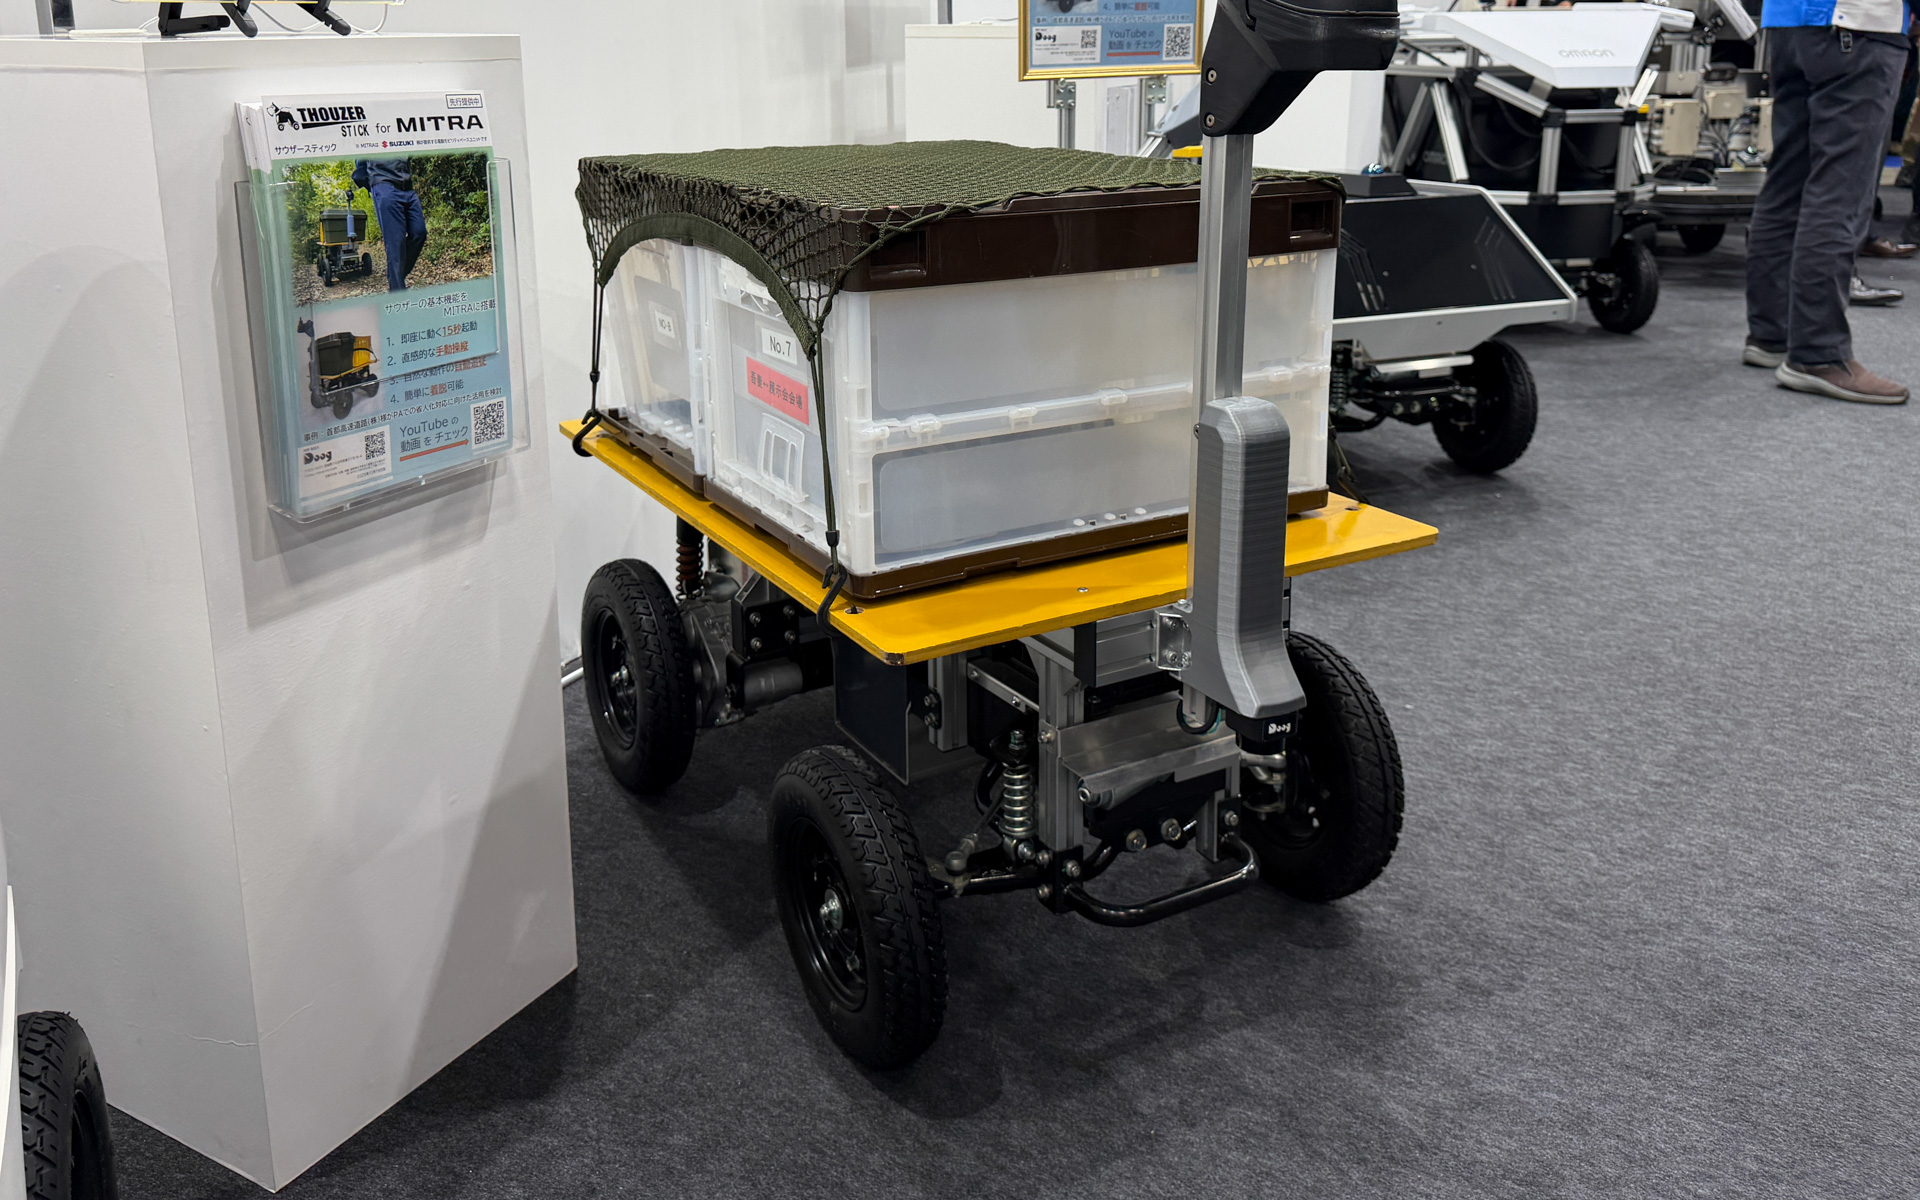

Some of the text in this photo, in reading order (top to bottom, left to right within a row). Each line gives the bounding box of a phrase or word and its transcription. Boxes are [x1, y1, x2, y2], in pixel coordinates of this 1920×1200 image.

[1109, 29, 1147, 39] YouTube
[1134, 40, 1162, 49] チェック
[296, 106, 367, 122] THOUZER
[341, 115, 484, 137] STICK for MITRA
[274, 143, 337, 155] サウザースティック
[384, 292, 468, 315] サウザーの基本機能を
[443, 299, 497, 317] MITRAに搭載
[386, 321, 478, 347] 1. 即座に動く15秒起動
[769, 335, 792, 358] No.7
[387, 355, 397, 366] 2.
[390, 394, 399, 404] 4.
[400, 416, 459, 438] YouTube の
[400, 426, 469, 453] 動画 を チェック
[304, 450, 332, 465] Doog
[1268, 722, 1291, 735] Doog
